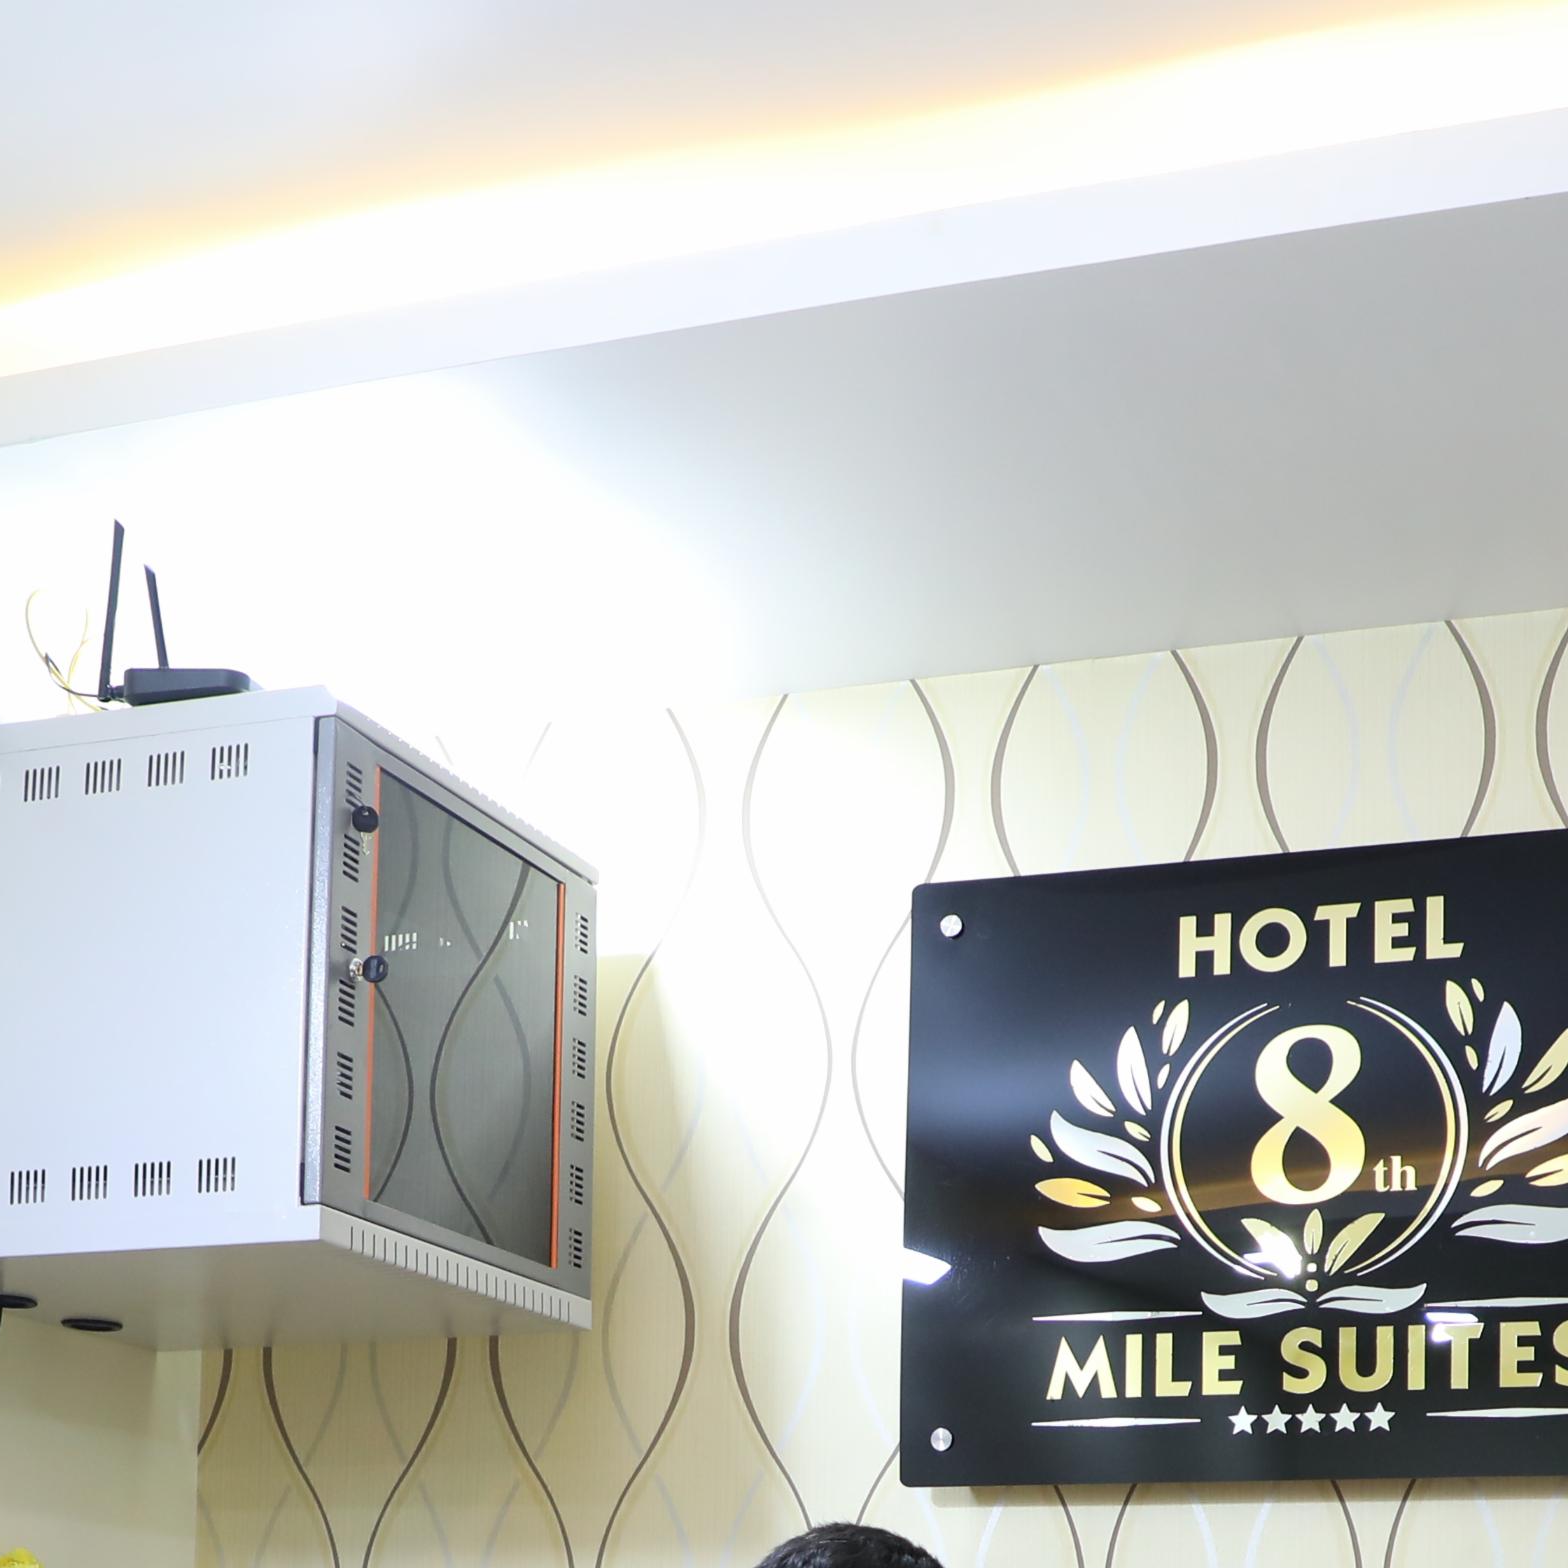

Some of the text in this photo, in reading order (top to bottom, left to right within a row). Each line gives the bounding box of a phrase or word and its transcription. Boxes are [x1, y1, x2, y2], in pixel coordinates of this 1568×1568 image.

[1178, 895, 1465, 978] HOTEL
[1250, 1024, 1418, 1204] 8th
[1047, 1330, 1244, 1402] MILE
